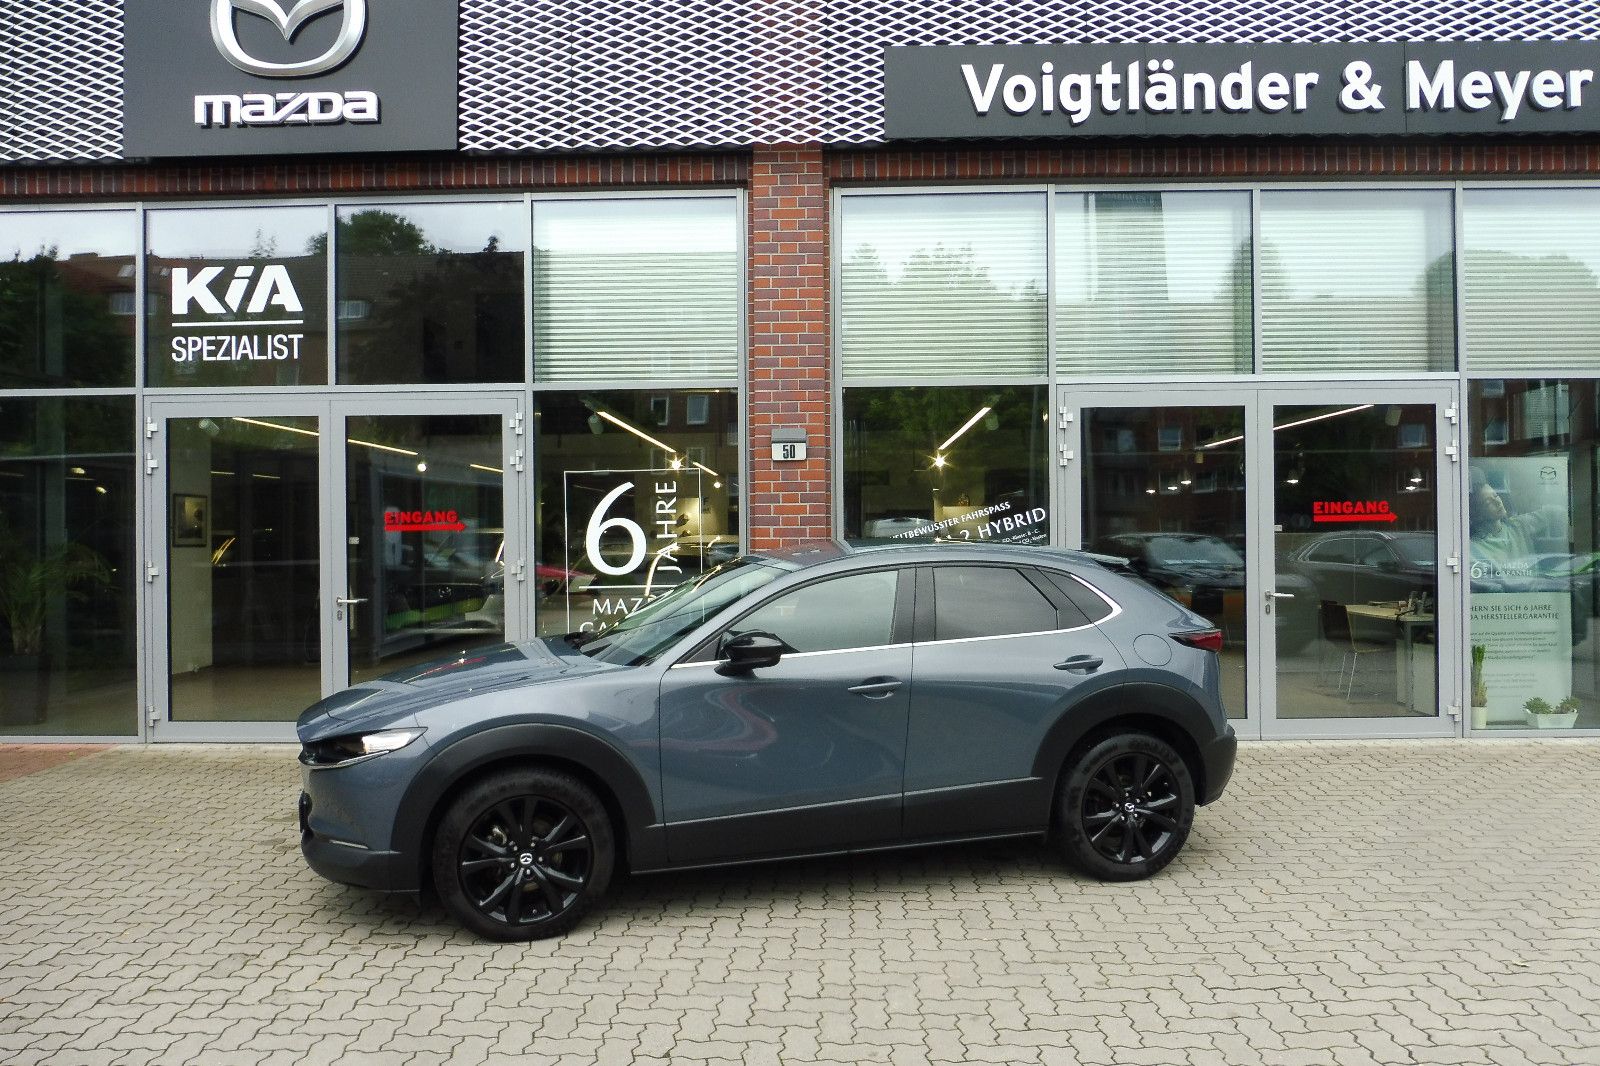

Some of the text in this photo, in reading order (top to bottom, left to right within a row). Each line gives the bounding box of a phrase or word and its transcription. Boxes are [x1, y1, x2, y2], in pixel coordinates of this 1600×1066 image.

[961, 58, 1594, 124] Voigtländer & Meyer
[171, 333, 304, 362] SPEZIALIST
[782, 444, 796, 459] 50
[384, 511, 458, 523] EINGANG
[960, 501, 1011, 523] FAHRSPASS
[1313, 500, 1390, 514] EINGANG
[585, 481, 647, 576] 6
[655, 480, 682, 574] JAHRE
[977, 507, 1046, 539] HYBRID
